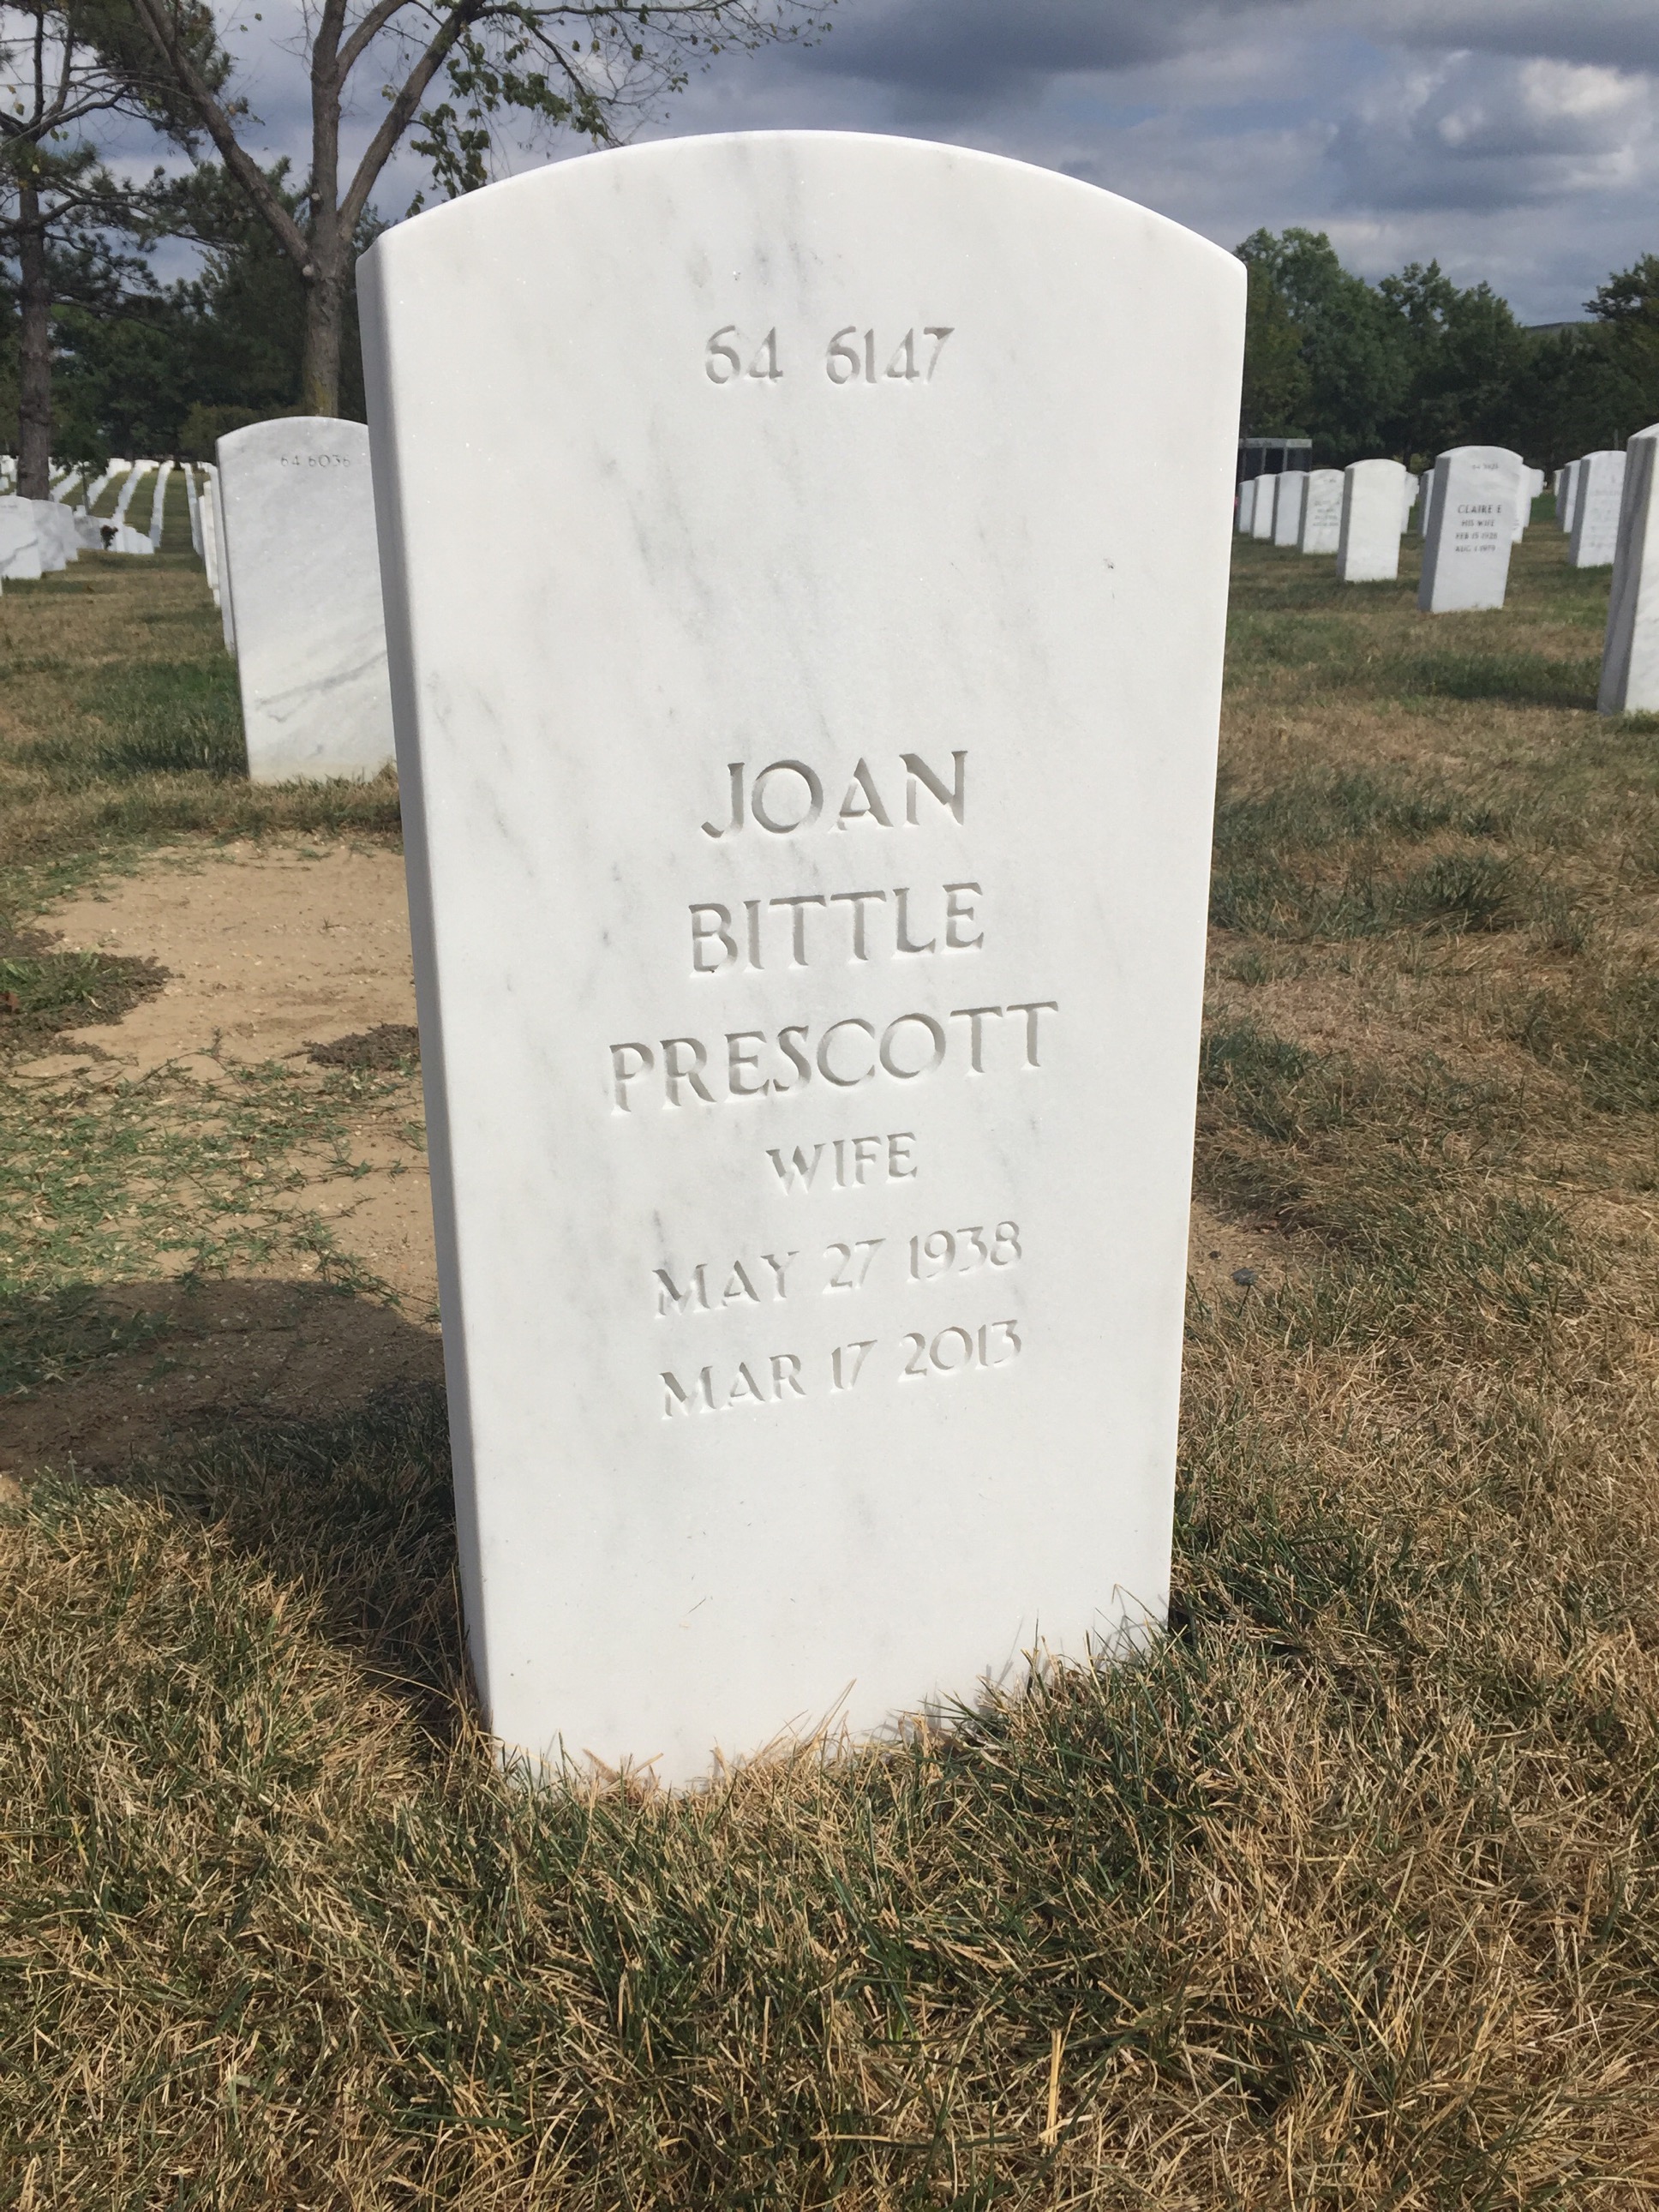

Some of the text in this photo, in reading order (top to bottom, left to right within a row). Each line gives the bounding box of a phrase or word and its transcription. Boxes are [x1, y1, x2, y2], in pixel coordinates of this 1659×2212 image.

[704, 325, 955, 384] 64 6147
[280, 454, 350, 467] 64 6036
[1455, 531, 1470, 540] FEB
[1457, 504, 1503, 514] CLAIRE E
[1461, 519, 1495, 527] HIS WIFE
[1454, 544, 1471, 553] AUG
[700, 750, 968, 839] JOAN
[688, 882, 985, 978] BITTLE
[609, 1001, 1058, 1115] PRESCOTT
[765, 1132, 918, 1196] WIFE
[651, 1220, 1023, 1318] MAY 27 1938
[659, 1319, 1022, 1420] MAR 17 2013
